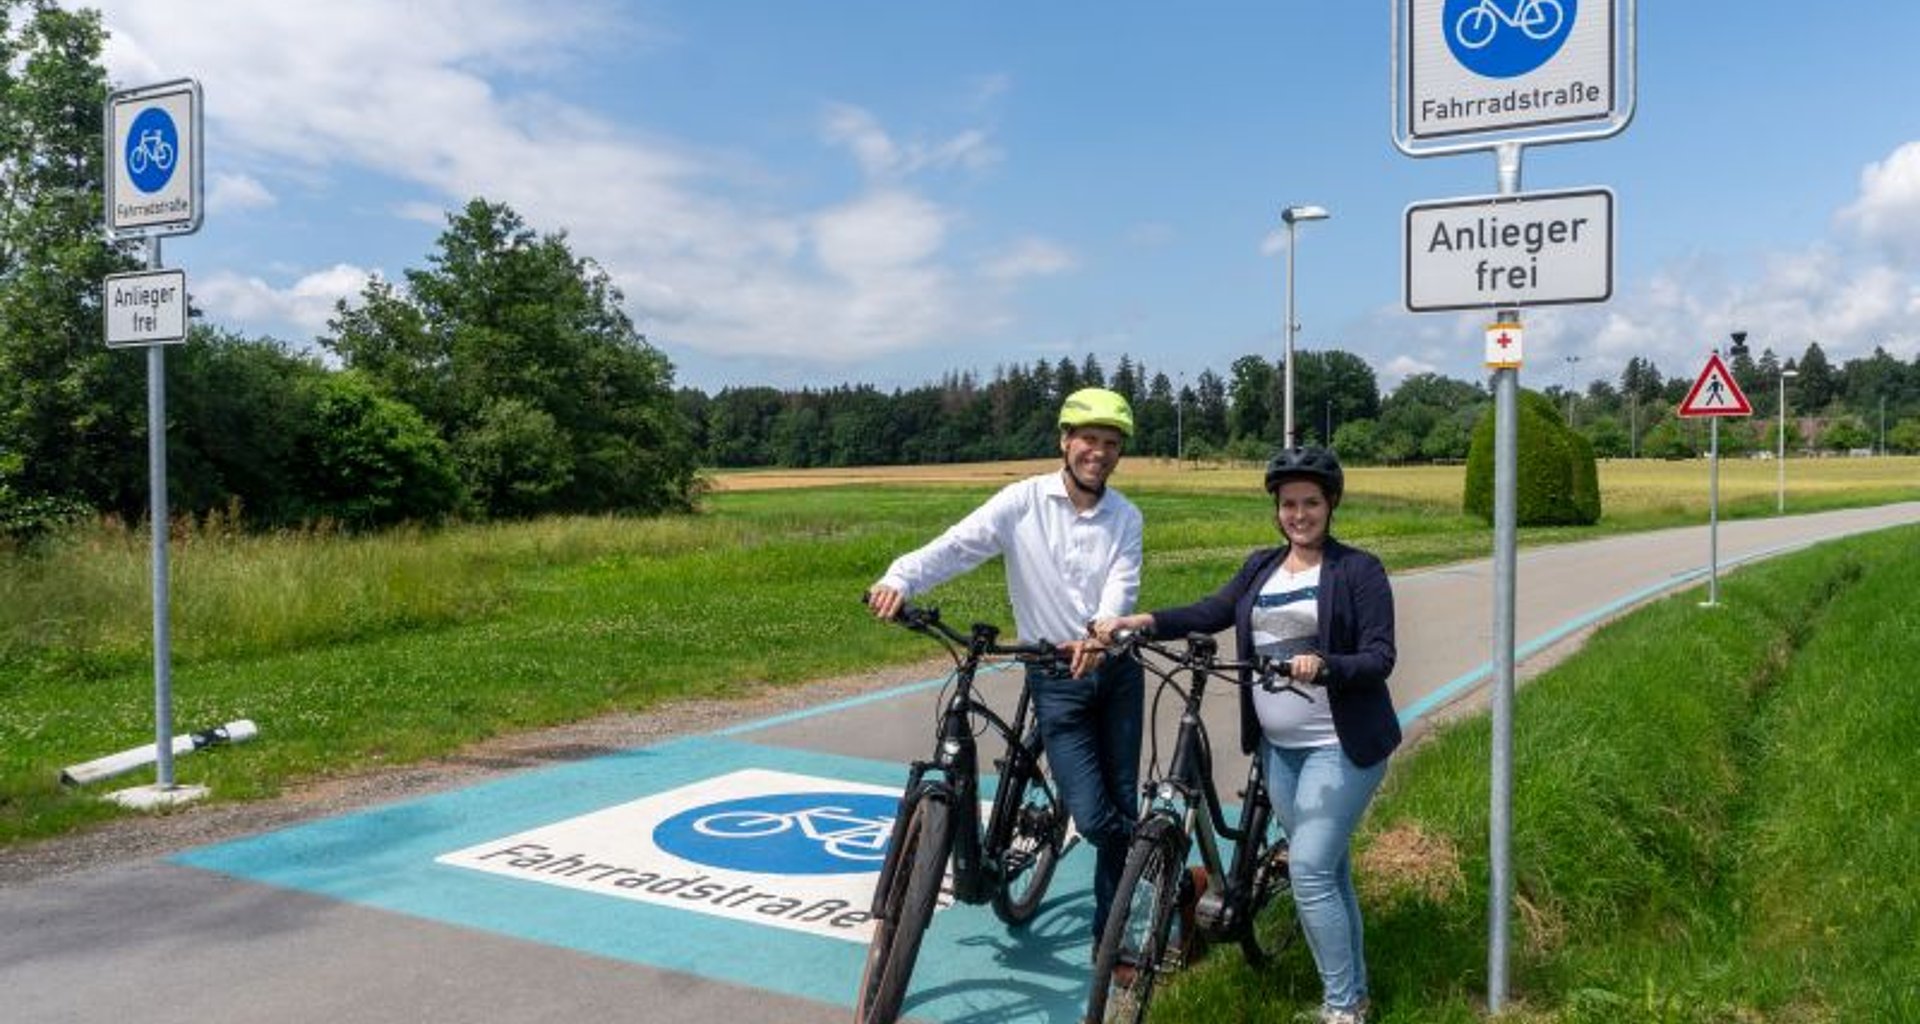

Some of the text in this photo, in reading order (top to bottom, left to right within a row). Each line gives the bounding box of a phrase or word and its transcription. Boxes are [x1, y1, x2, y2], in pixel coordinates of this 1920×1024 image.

[1422, 82, 1600, 121] Fahrradstraße
[1428, 217, 1588, 254] Anlieger
[1475, 256, 1538, 291] frei
[114, 285, 176, 308] Anlieger
[133, 309, 157, 332] frei
[478, 844, 873, 928] Fahrradstraße
